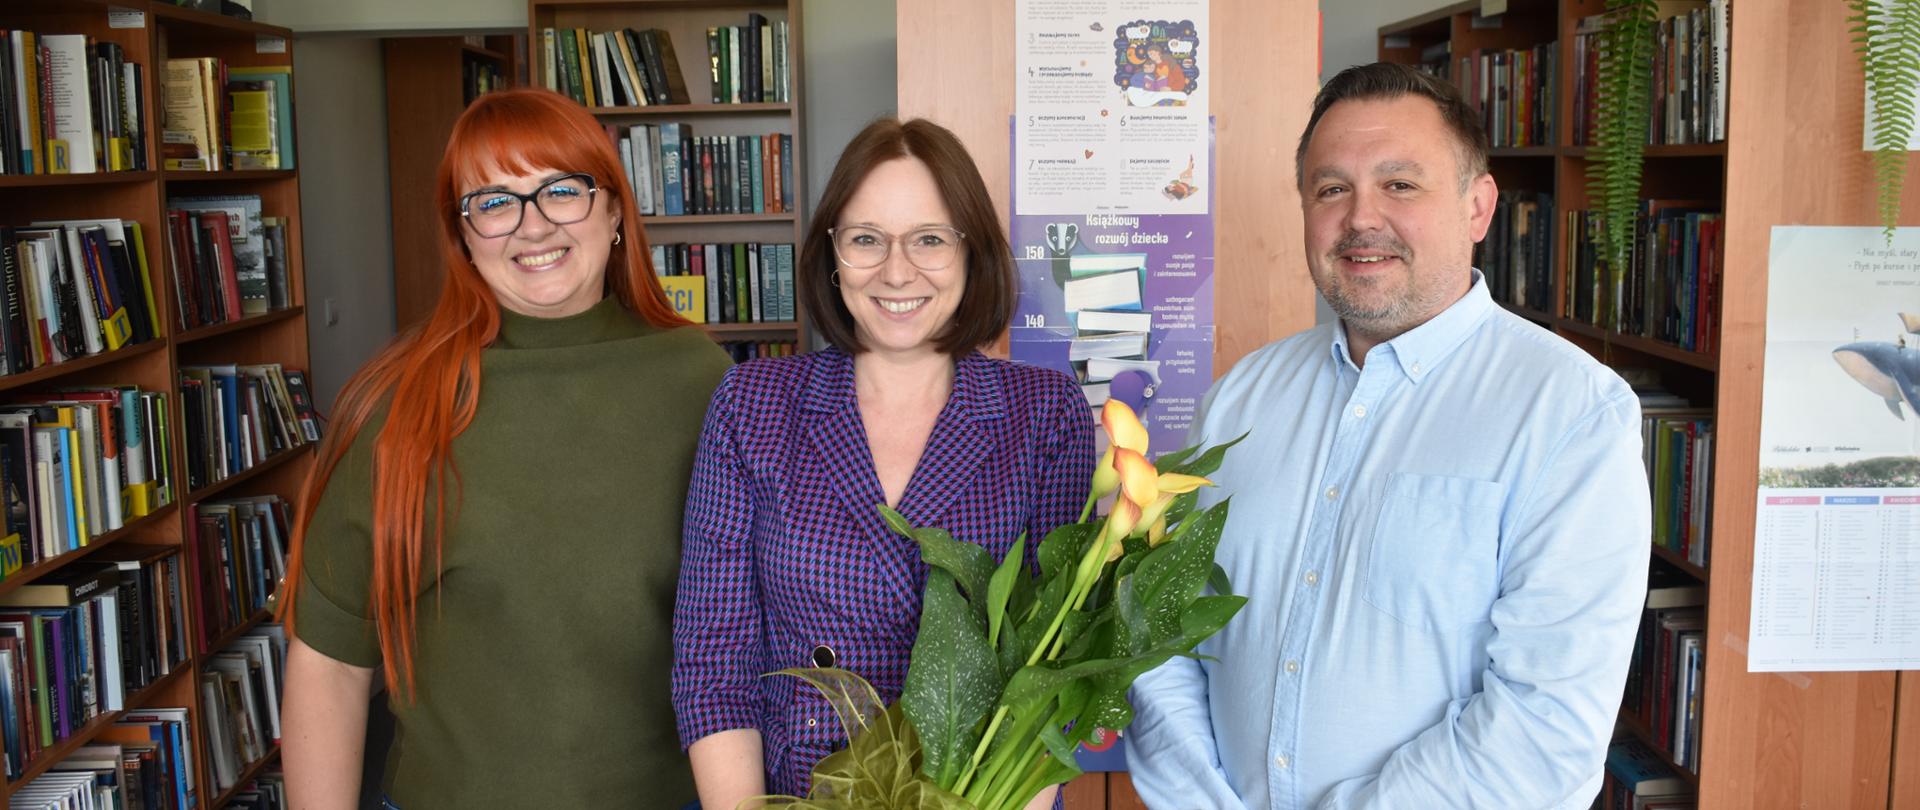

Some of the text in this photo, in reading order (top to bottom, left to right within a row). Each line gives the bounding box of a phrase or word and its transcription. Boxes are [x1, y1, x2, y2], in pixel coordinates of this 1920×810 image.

[1028, 66, 1035, 77] 4
[1028, 116, 1035, 127] 5
[1120, 115, 1127, 127] 6
[55, 145, 67, 170] R
[1028, 159, 1035, 170] 7
[1086, 214, 1139, 229] Książkowy
[1095, 231, 1168, 247] rozwój dziecka
[1025, 246, 1045, 259] 150
[1863, 248, 1875, 257] Nie
[1899, 248, 1918, 259] stary
[1873, 263, 1881, 273] po
[3, 246, 18, 321] CHURCHILL
[1025, 315, 1045, 328] 140
